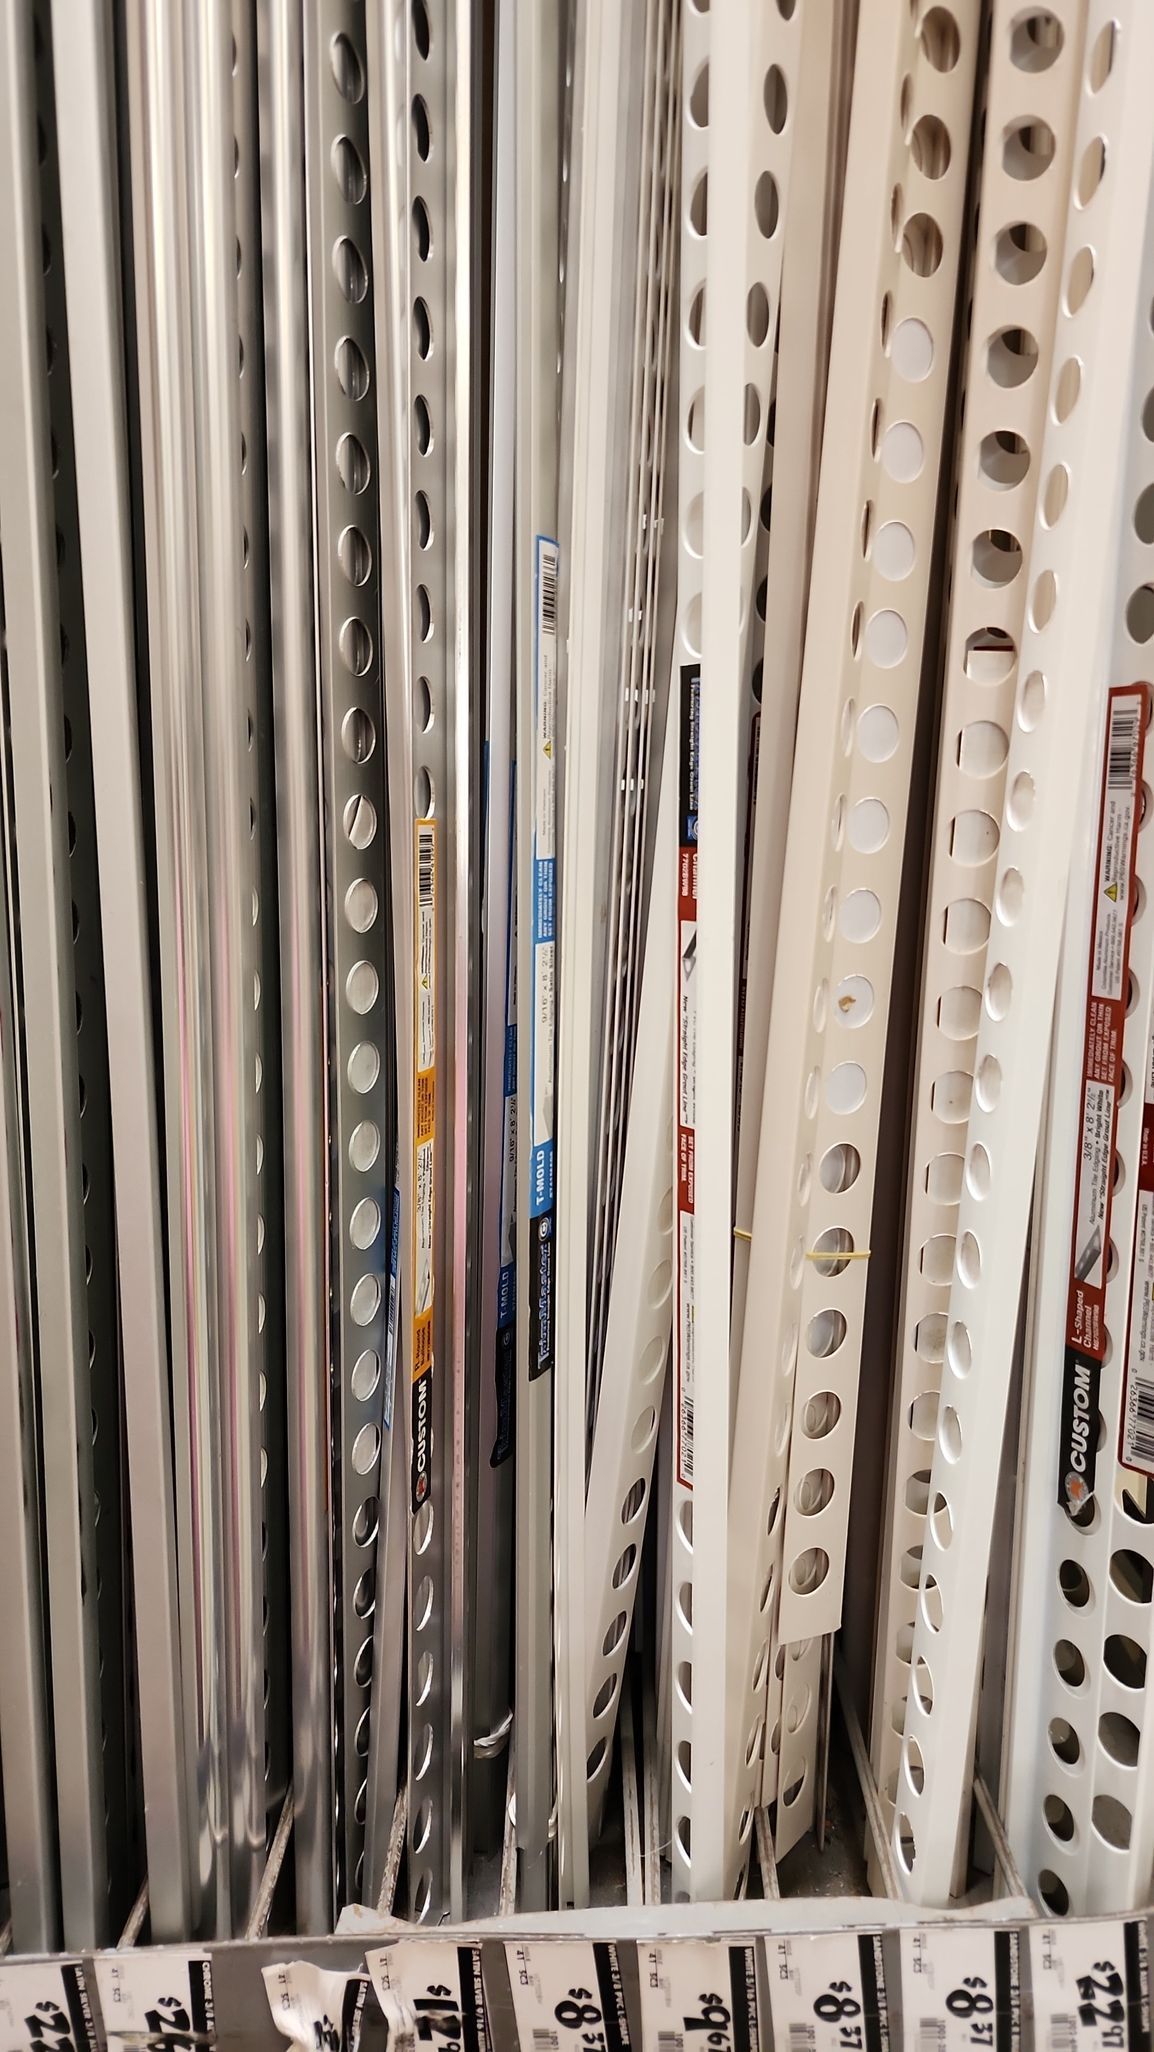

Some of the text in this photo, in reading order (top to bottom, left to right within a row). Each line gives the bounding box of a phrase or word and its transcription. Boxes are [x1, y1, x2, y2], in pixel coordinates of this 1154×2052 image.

[1087, 1002, 1097, 1077] IMMEDIATELY CLEAN
[1097, 1023, 1103, 1034] OR
[1103, 1006, 1112, 1041] EXPOSED
[1109, 1051, 1115, 1062] OF
[1086, 1113, 1095, 1124] 8'
[1095, 1114, 1103, 1138] Bright
[1102, 1121, 1110, 1142] Grout
[681, 1152, 686, 1161] OF
[1083, 1136, 1093, 1160] 3/8"
[1093, 1148, 1101, 1172] Edging
[1101, 1144, 1109, 1163] Edge
[536, 1150, 545, 1206] T-MOLD
[1089, 1189, 1098, 1224] Aluminum
[500, 1272, 509, 1318] T-MOLD
[538, 1244, 550, 1369] TrimMaster
[1073, 1291, 1085, 1345] L-Shaped
[1083, 1306, 1092, 1348] Channel
[1129, 1384, 1137, 1413] 26366
[417, 1379, 427, 1472] CUSTOM
[1070, 1364, 1092, 1473] CUSTOM
[1127, 1417, 1136, 1446] 77021
[516, 1950, 528, 1985] 41 SC3
[649, 1953, 658, 1988] 41 SC3
[779, 1964, 788, 1980] SC3
[1009, 1933, 1019, 1987] SANDSTONE
[202, 1962, 214, 2018] CHROME 3/8
[355, 1981, 368, 2007] SATIN
[472, 1949, 485, 2029] SATIN SILVER 9/16
[608, 1945, 629, 2045] WHITE 3/8 PVC L-SHAPE
[744, 1948, 756, 2018] WHITE 5/16 PVC
[873, 1936, 889, 2026] SANDSTONE 3/8 PVC
[1010, 1989, 1019, 2005] 3/8
[80, 1992, 91, 2019] SILVER
[85, 2021, 93, 2036] 3/8
